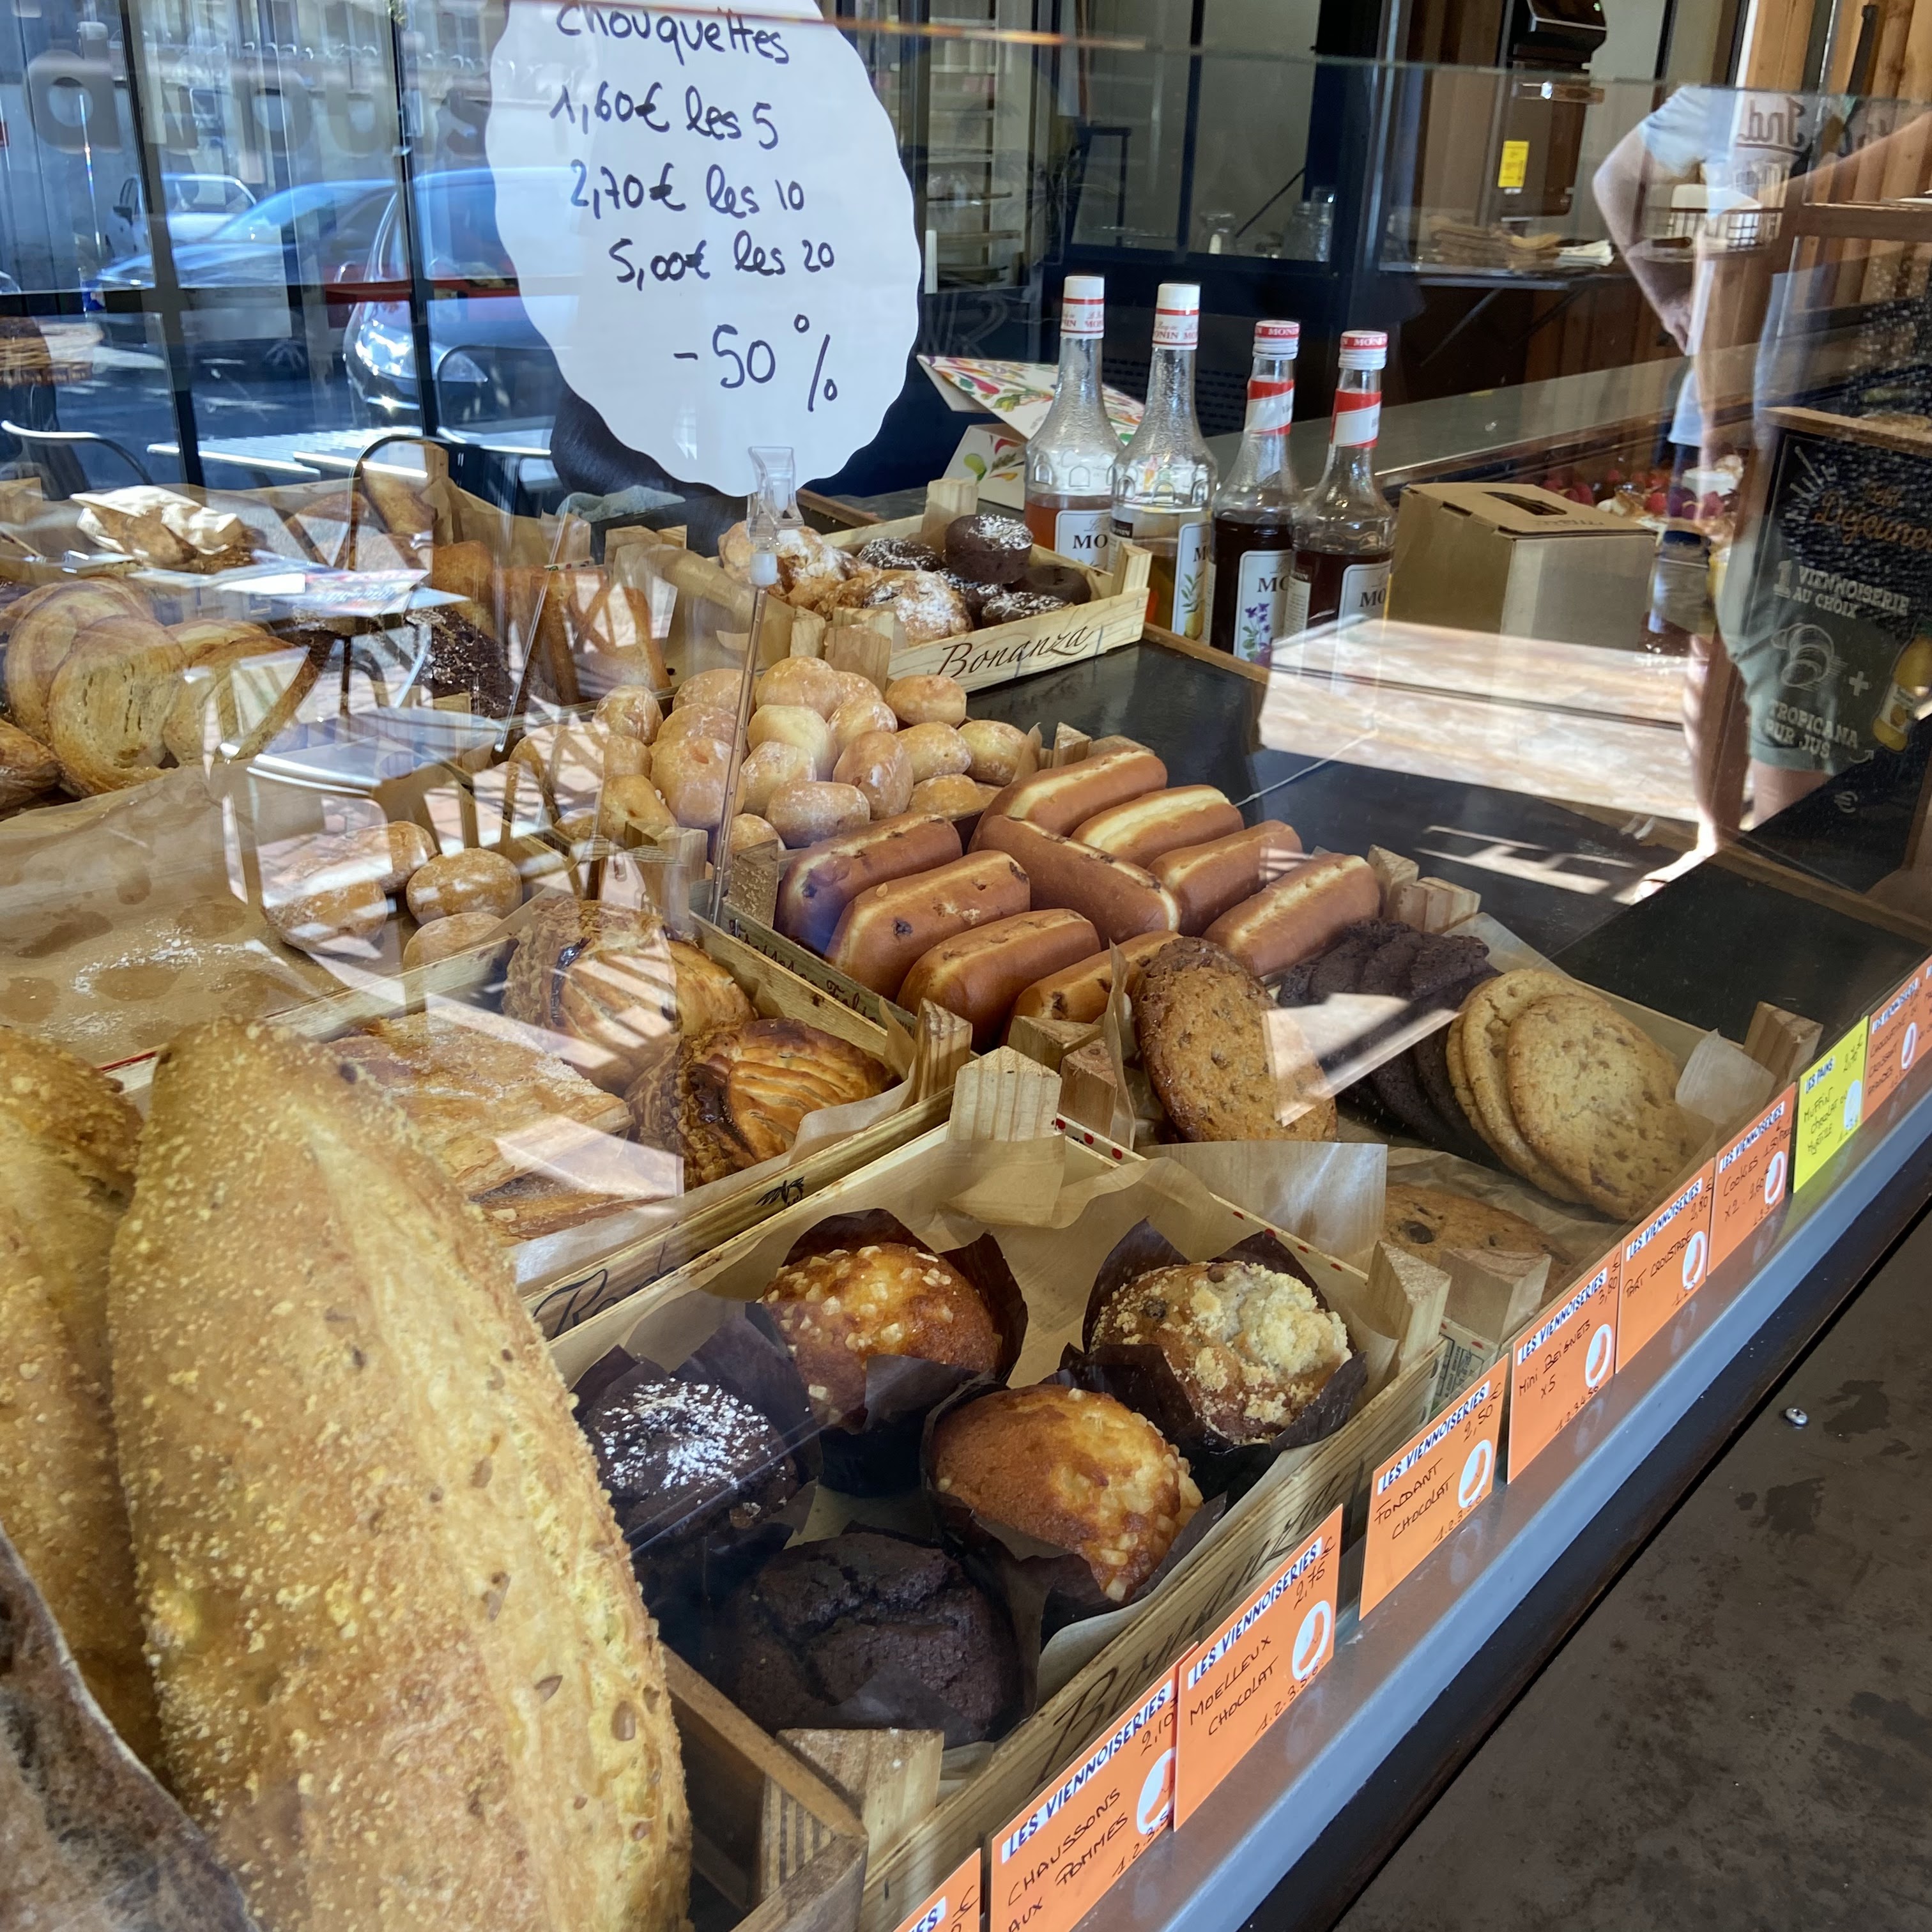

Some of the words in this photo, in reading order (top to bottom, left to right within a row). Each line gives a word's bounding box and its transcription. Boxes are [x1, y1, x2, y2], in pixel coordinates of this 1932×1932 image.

[549, 81, 670, 134] 1,60€
[686, 85, 742, 139] les
[753, 103, 778, 150] 5
[570, 159, 686, 218] 2,70€
[707, 164, 760, 218] les
[774, 180, 804, 211] 10
[608, 238, 711, 291] 5,00€
[734, 230, 786, 277] les
[802, 240, 834, 272] 20
[936, 625, 1094, 678] Bonanza
[1798, 734, 1831, 758] JUS
[1629, 1234, 1642, 1259] LES
[1645, 1179, 1699, 1244] VIENNOISERIES
[1521, 1334, 1537, 1363] LES
[1540, 1270, 1604, 1345] VIENNOISERIES
[1382, 1458, 1402, 1492] LES
[1406, 1383, 1485, 1469] VIENNOISERIES
[1374, 1457, 1442, 1529] FONDANT
[1392, 1472, 1454, 1541] CHOCOLAT
[1193, 1644, 1216, 1686] LES
[1222, 1542, 1317, 1656] VIENNOISERIES
[1190, 1630, 1272, 1727] MOELLEUX
[1208, 1655, 1278, 1738] CHOCOLAT
[1009, 1810, 1038, 1859] LES
[1046, 1685, 1165, 1821] VIENNOISERIES
[1008, 1783, 1120, 1907] CHAUSSONS
[1009, 1894, 1043, 1932] AUX
[1055, 1807, 1128, 1894] POMMES
